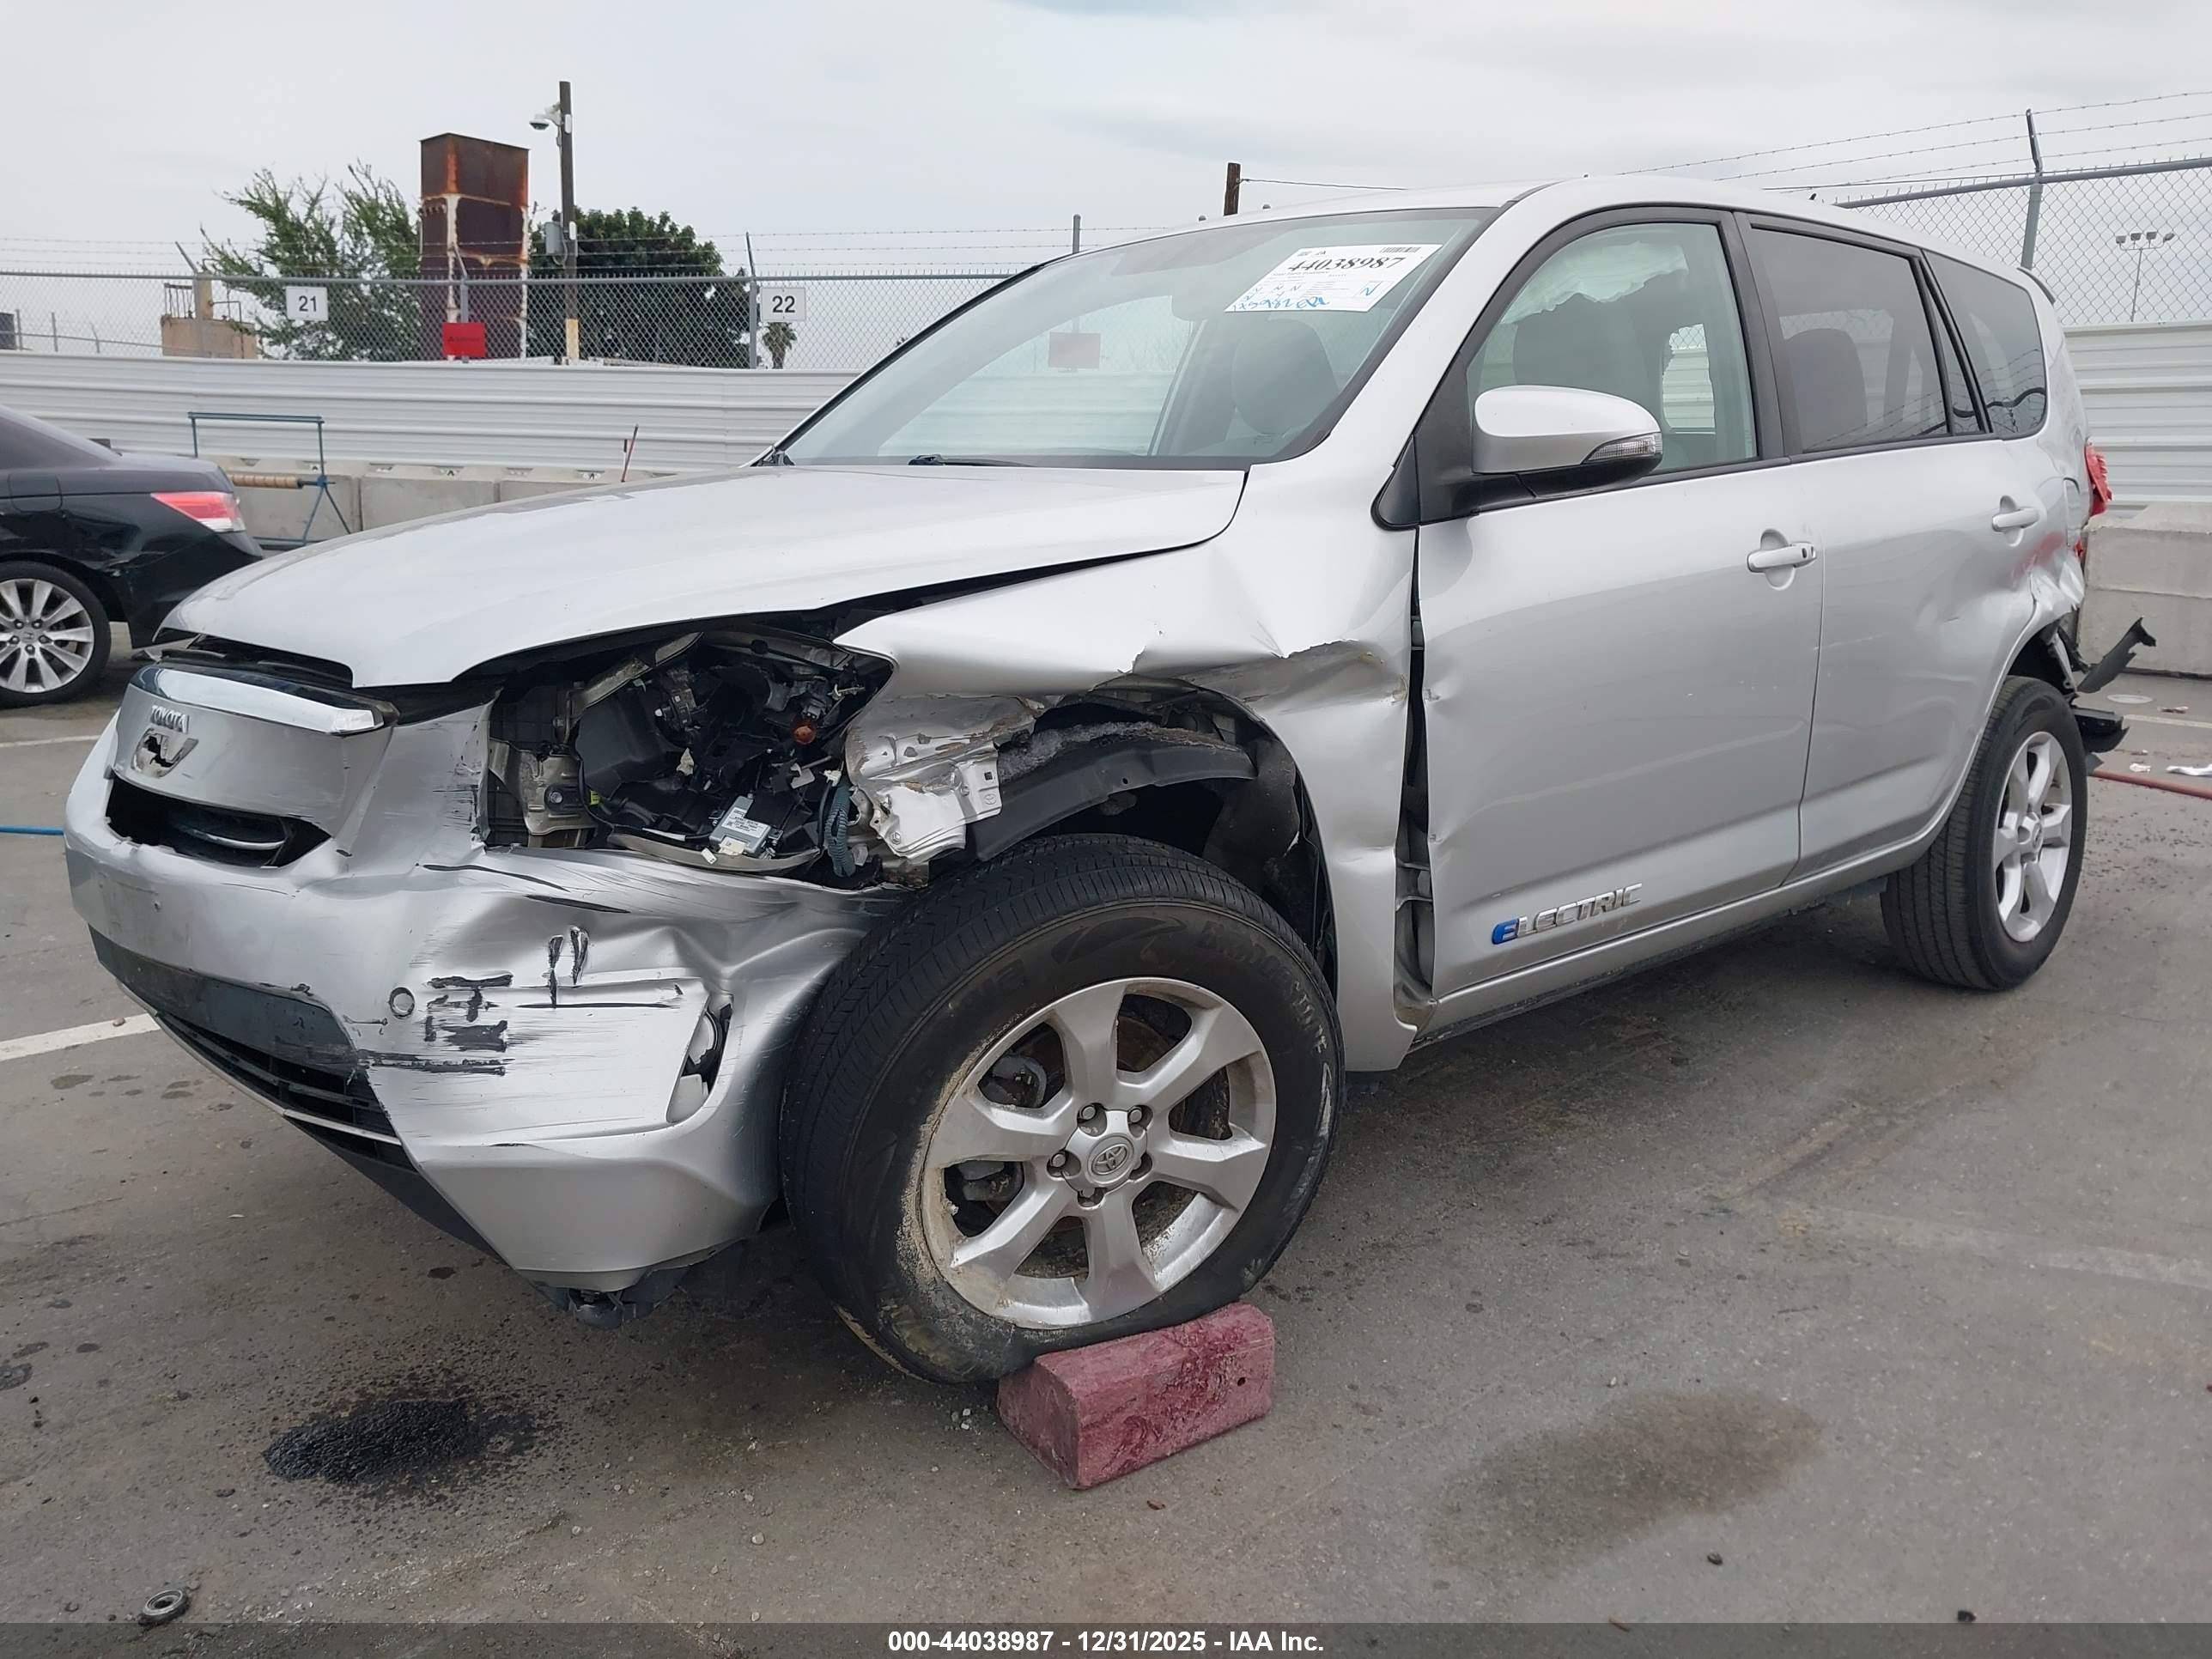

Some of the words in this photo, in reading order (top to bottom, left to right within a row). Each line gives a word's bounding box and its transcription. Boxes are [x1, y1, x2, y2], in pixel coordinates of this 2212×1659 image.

[1287, 257, 1406, 271] 44038987
[299, 295, 317, 312] 21
[772, 295, 795, 313] 22
[150, 704, 190, 733] TOYOTA
[1491, 883, 1643, 945] ELECTRIC
